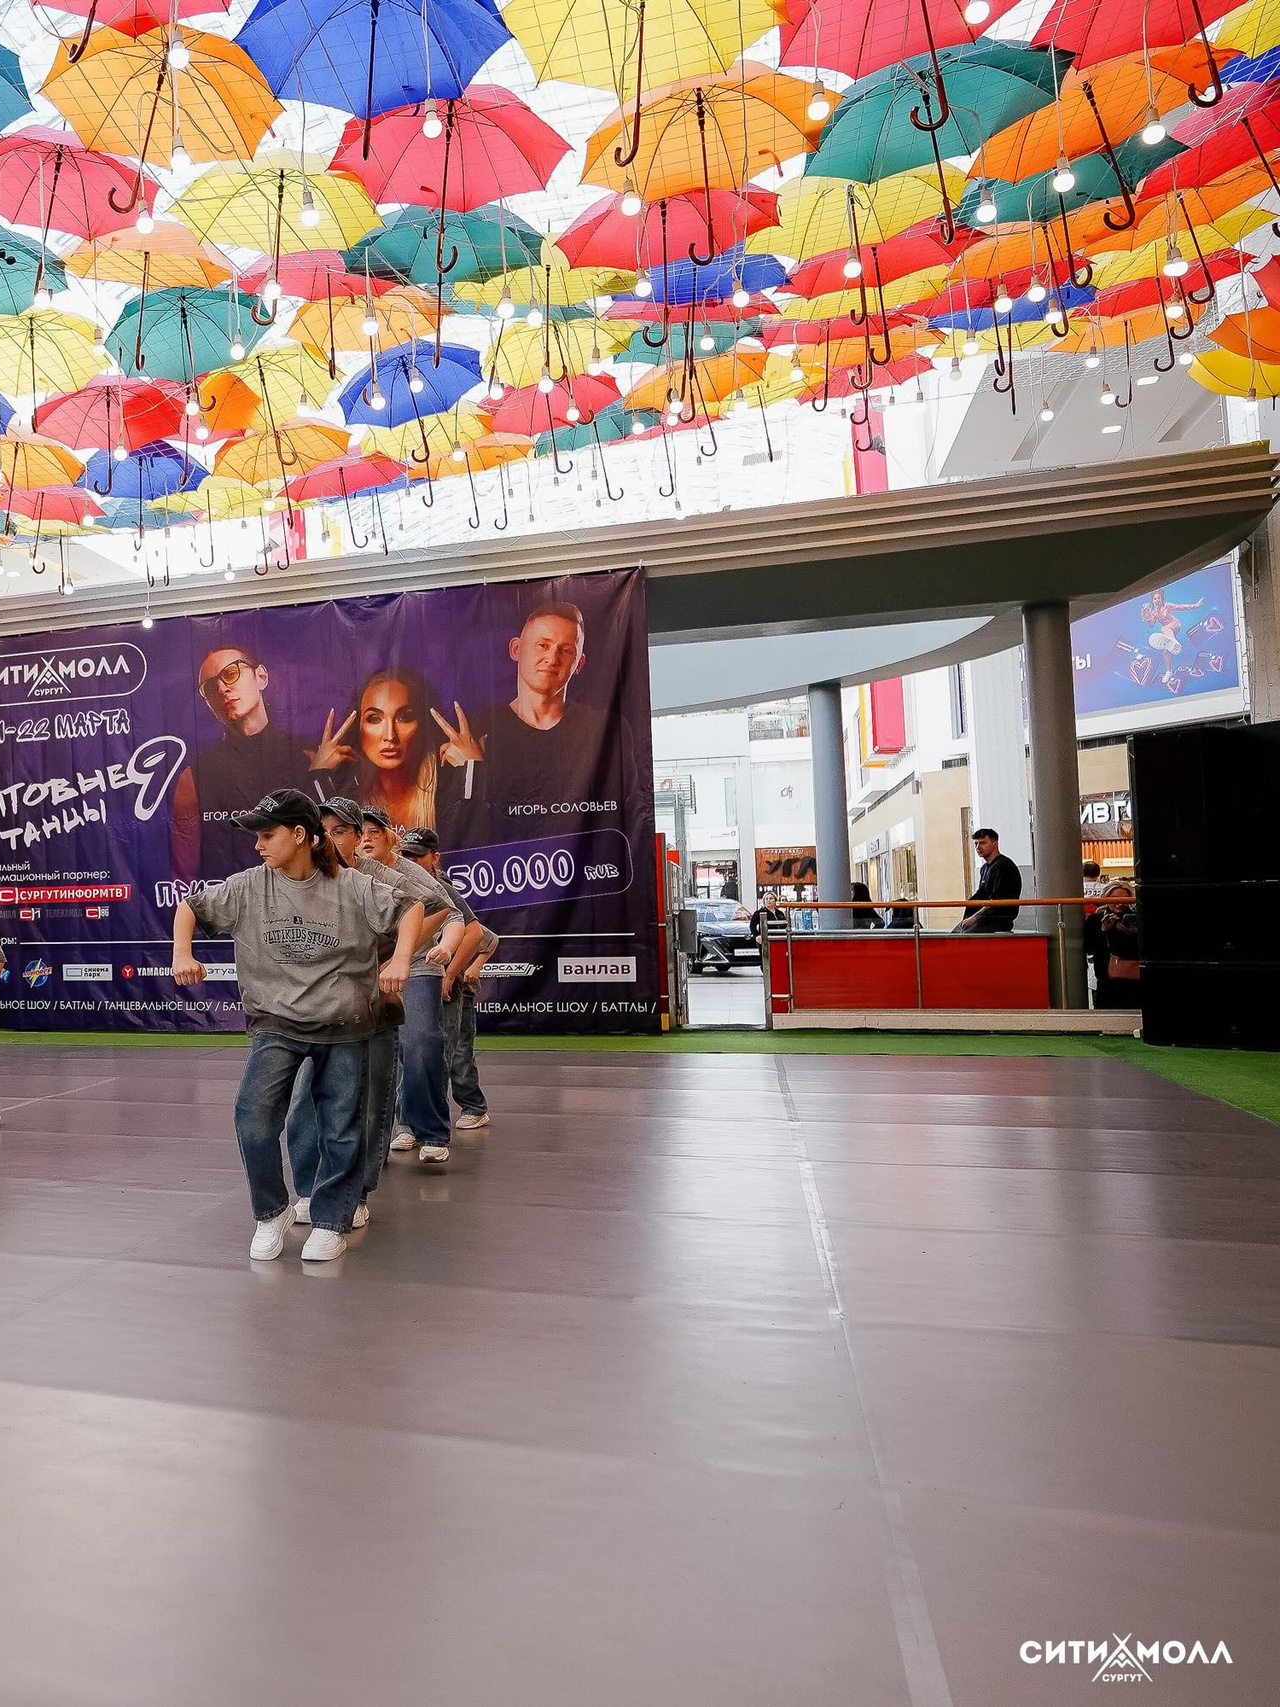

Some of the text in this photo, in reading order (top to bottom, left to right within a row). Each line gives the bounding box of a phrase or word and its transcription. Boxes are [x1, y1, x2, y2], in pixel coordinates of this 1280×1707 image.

[58, 655, 131, 679] МОЛЛ
[34, 686, 64, 697] СУРГУТ
[54, 708, 131, 740] МАРТА
[508, 801, 618, 816] ИГОРЬ СОЛОВЬЕВ
[203, 811, 228, 821] ЕГОР
[0, 799, 107, 850] ТАНЦЫ
[62, 870, 111, 882] партнер:
[583, 864, 620, 881] RUB
[307, 931, 341, 949] STUDIO
[563, 963, 631, 975] ванлав
[27, 1000, 51, 1010] ШОУ
[60, 1000, 95, 1011] БАТТЛЫ
[104, 1001, 183, 1012] ТАНЦЕВАЛЬНОЕ
[185, 1001, 212, 1012] ШОУ
[556, 1001, 589, 1013] ШОУ
[601, 1001, 648, 1013] БАТТЛЫ
